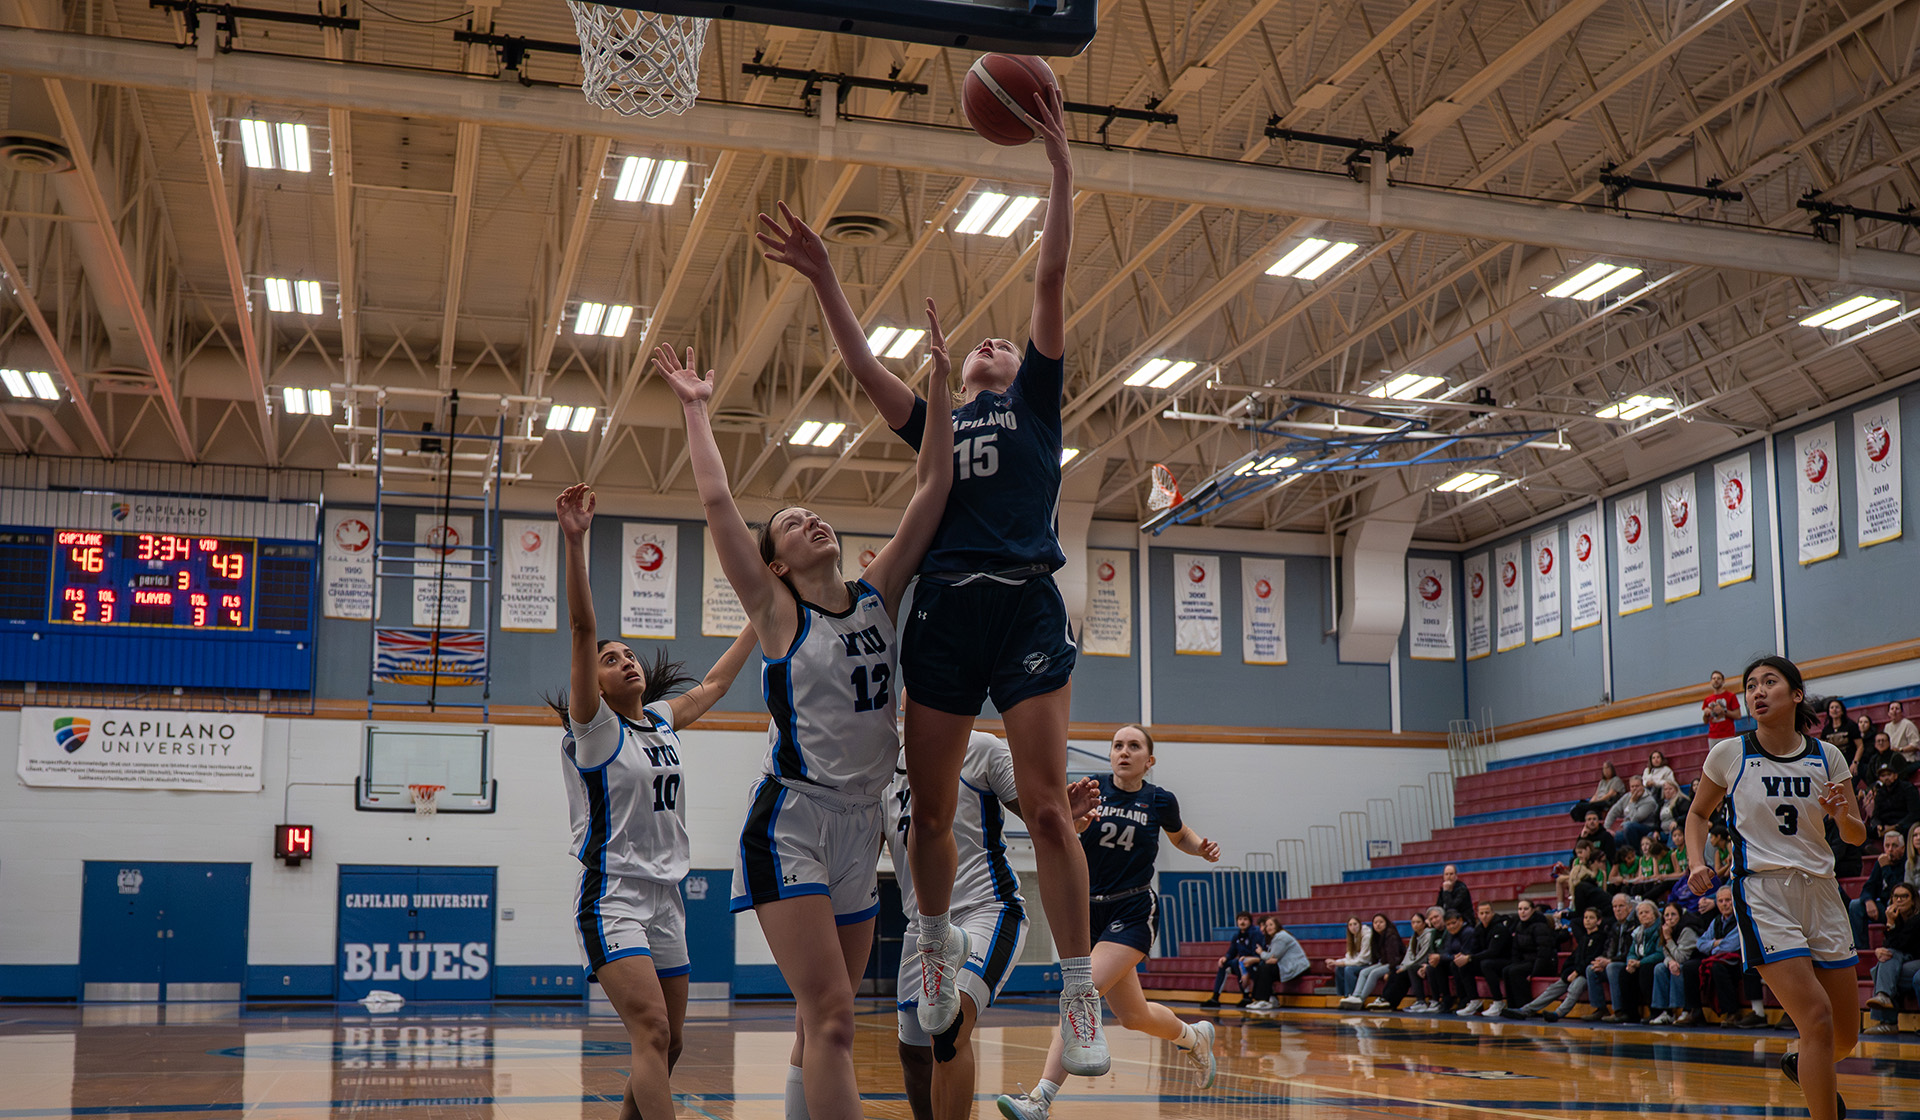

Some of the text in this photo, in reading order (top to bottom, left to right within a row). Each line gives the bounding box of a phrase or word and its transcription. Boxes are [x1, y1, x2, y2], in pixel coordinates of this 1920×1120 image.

[953, 433, 999, 480] 15
[1873, 483, 1890, 496] 2010
[135, 504, 208, 518] CAPILANO
[1811, 503, 1828, 516] 2008
[135, 515, 206, 525] UNIVERSITY
[138, 534, 191, 560] 3:34
[199, 538, 219, 551] VIU
[72, 546, 104, 573] 46
[212, 554, 244, 579] 43
[177, 571, 190, 590] 3
[65, 587, 85, 602] FLS
[135, 591, 172, 606] PLAYER
[222, 595, 242, 608] FLS
[501, 594, 555, 603] CHAMPIONS
[73, 602, 87, 622] 2
[100, 603, 113, 623] 3
[193, 607, 206, 627] 3
[229, 609, 242, 627] 4
[838, 624, 887, 657] VIU
[850, 662, 891, 713] 12
[102, 720, 235, 740] CAPILANO
[102, 740, 231, 756] UNIVERSITY
[642, 744, 681, 768] VIU
[652, 773, 681, 812] 10
[1761, 776, 1812, 798] VIU
[1096, 805, 1148, 826] CAPILANO
[1775, 804, 1799, 836] 3
[287, 828, 311, 852] 14
[1099, 821, 1136, 852] 24
[345, 893, 489, 909] CAPILANO UNIVERSITY
[343, 942, 490, 981] BLUES
